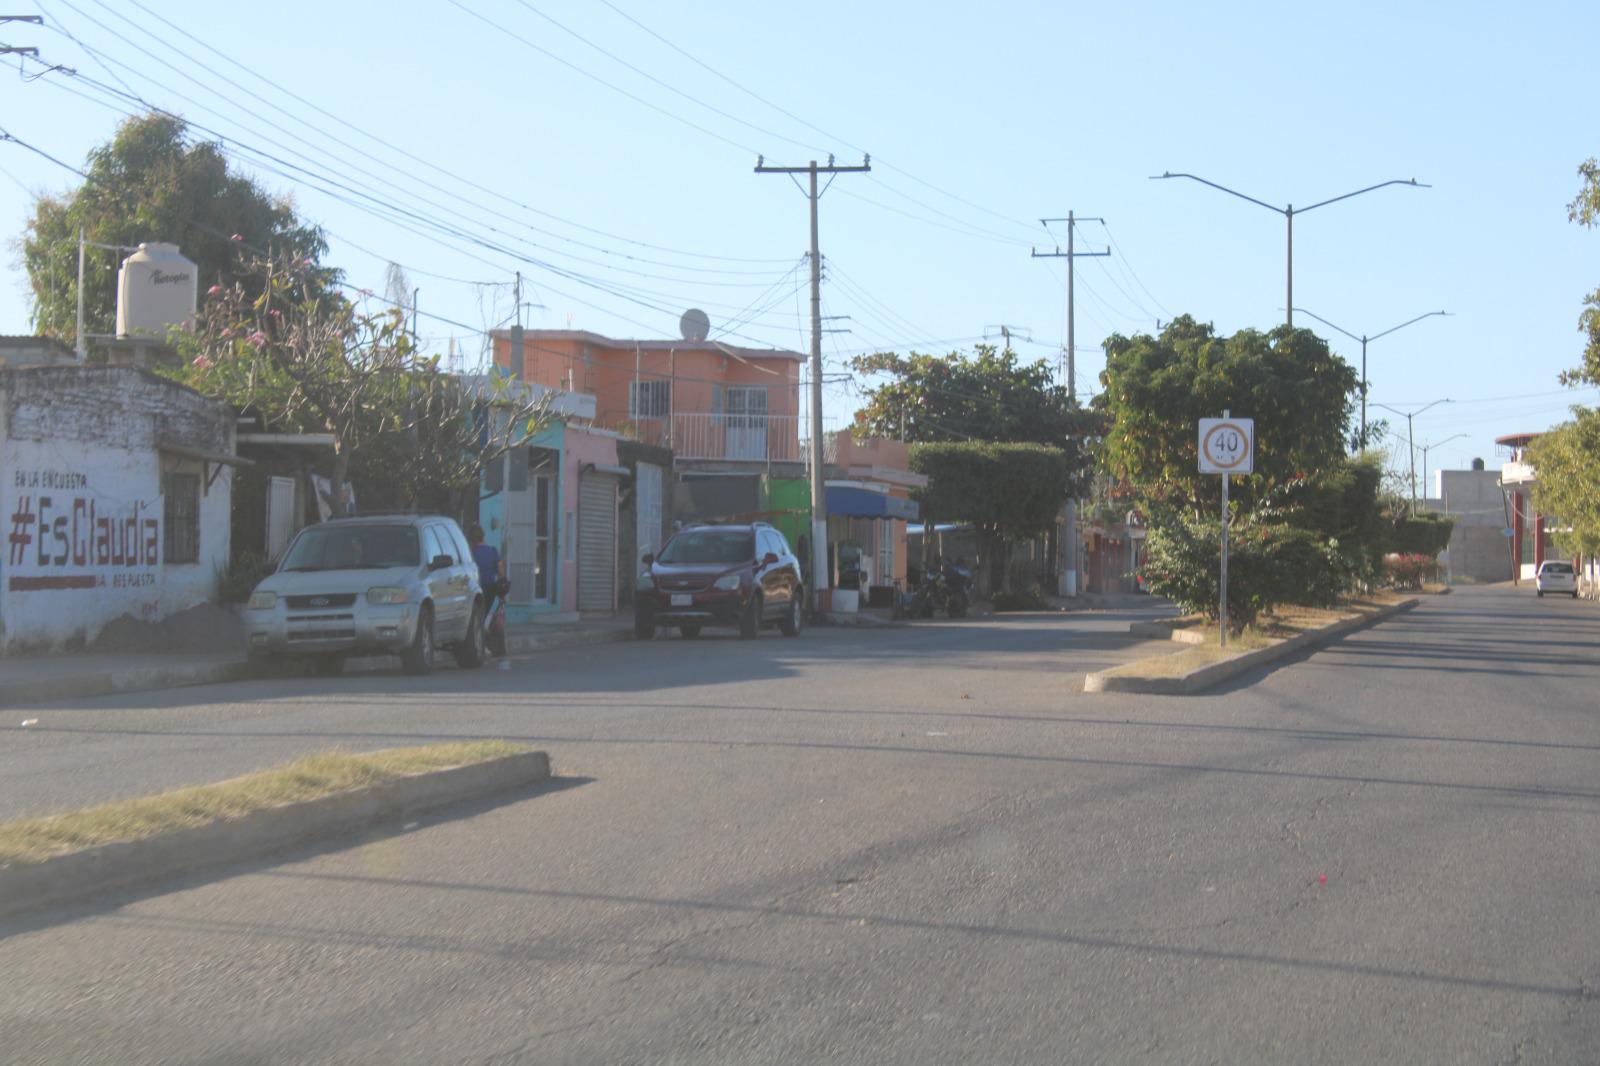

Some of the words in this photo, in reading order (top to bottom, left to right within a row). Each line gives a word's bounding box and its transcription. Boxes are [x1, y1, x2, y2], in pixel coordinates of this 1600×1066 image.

[1215, 431, 1238, 452] 40
[9, 496, 159, 567] #EsClaudia
[113, 573, 156, 588] RESPUESTA
